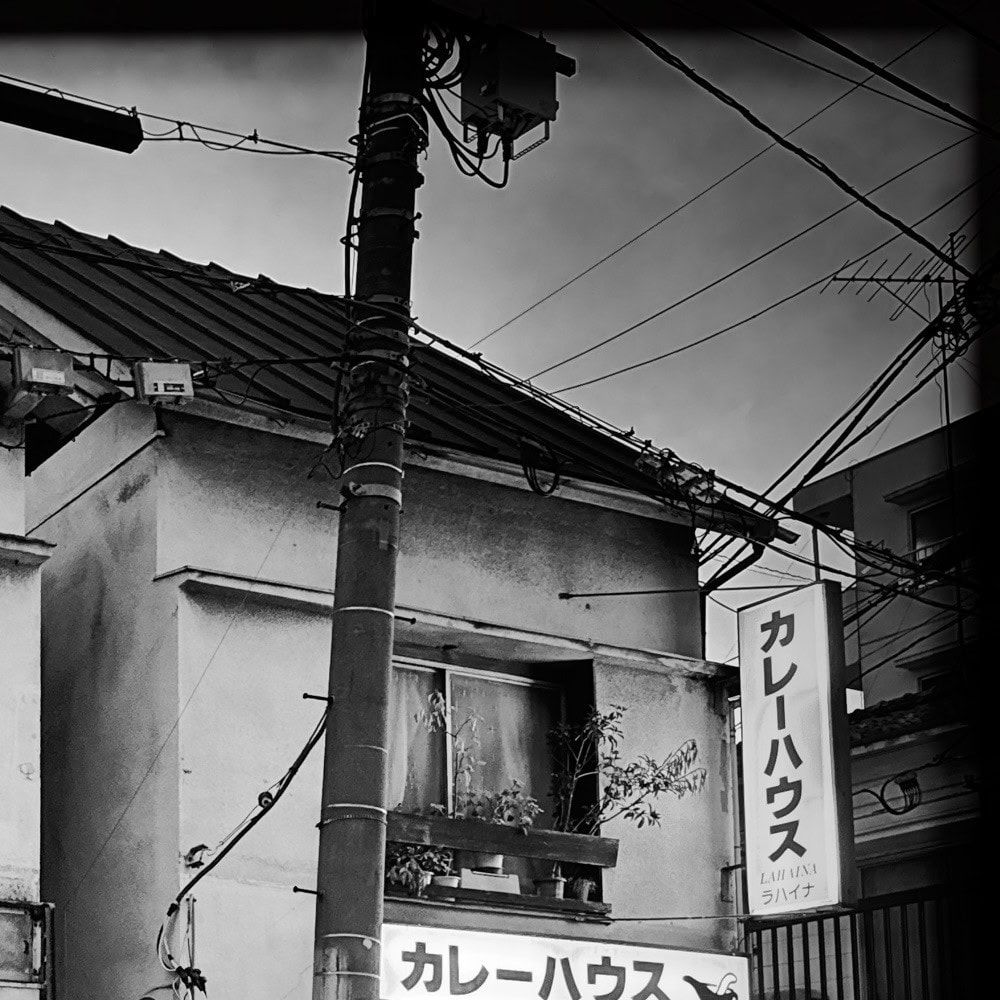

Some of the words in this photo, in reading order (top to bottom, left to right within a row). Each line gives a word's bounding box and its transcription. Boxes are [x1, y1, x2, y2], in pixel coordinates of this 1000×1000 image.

[760, 610, 807, 863] カレーハウス
[762, 882, 815, 905] ラハイナ
